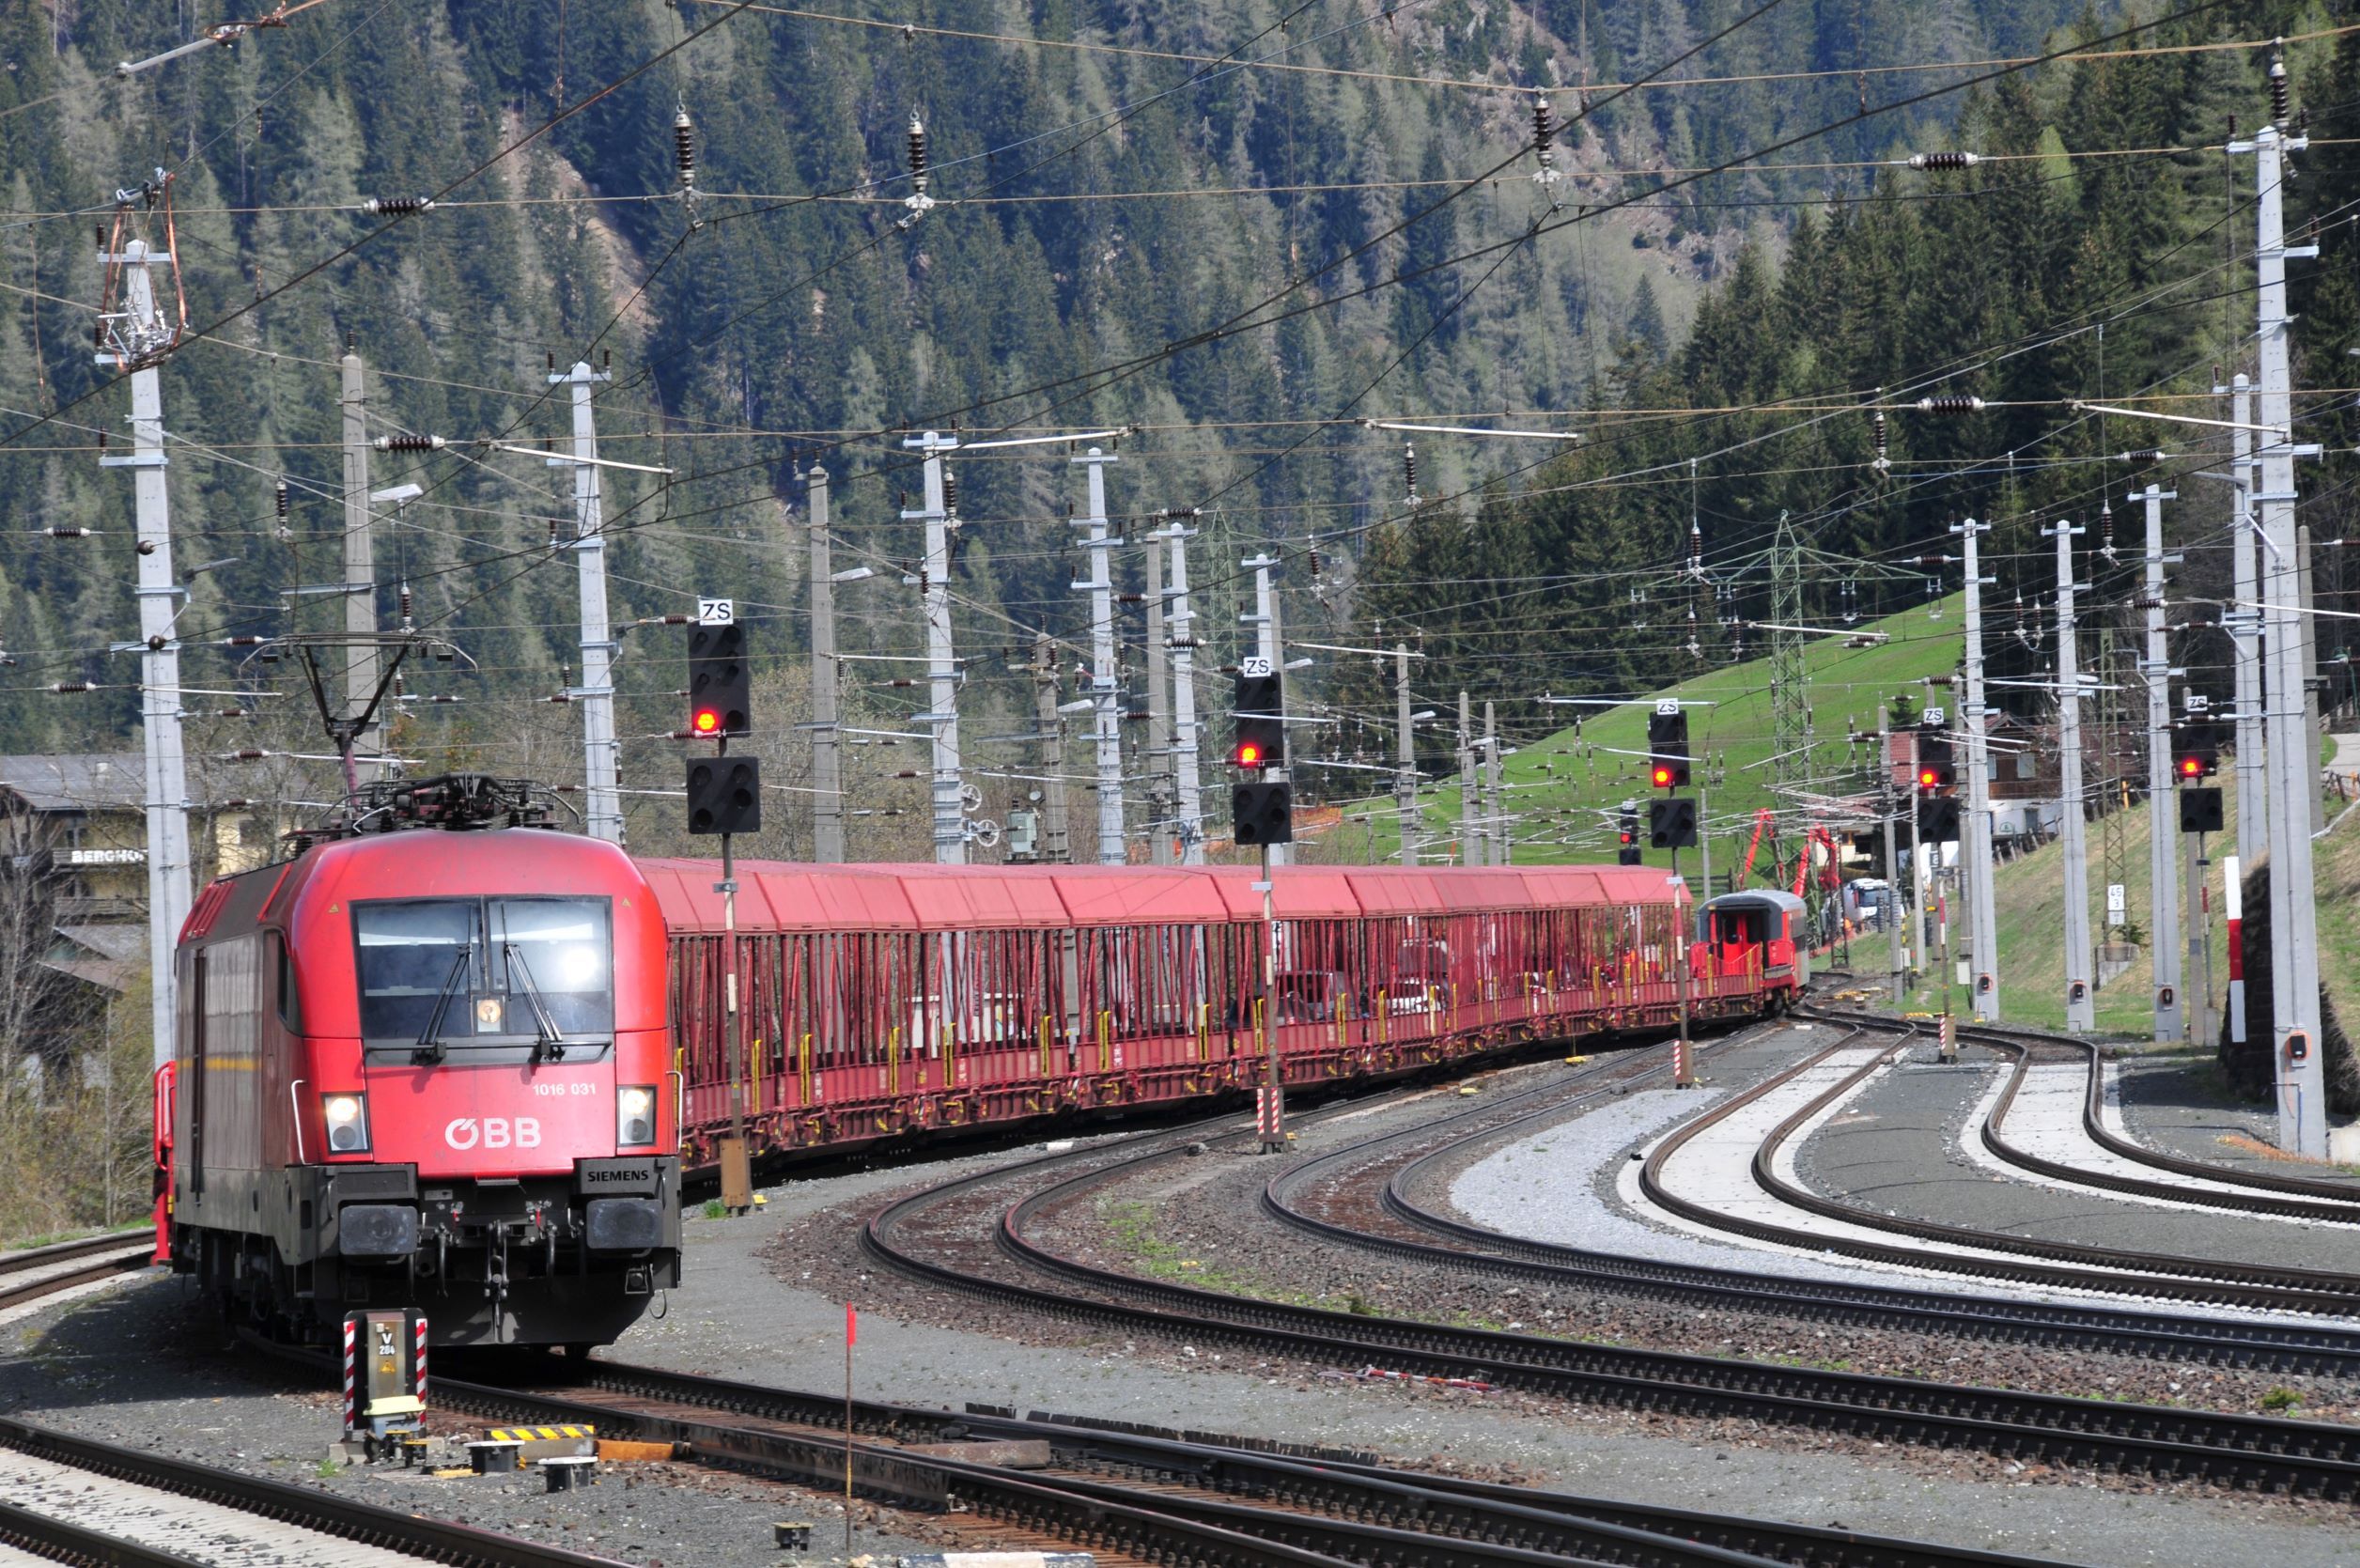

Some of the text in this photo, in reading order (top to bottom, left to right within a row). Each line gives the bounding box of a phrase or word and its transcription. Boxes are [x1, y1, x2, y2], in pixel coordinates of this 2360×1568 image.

[702, 603, 732, 620] ZS
[1246, 660, 1270, 674] ZS
[1926, 710, 1943, 722] ZS
[533, 1083, 597, 1096] 1016 031
[444, 1117, 542, 1151] ÖBB
[587, 1170, 649, 1183] SIEMENS
[381, 1333, 393, 1344] V
